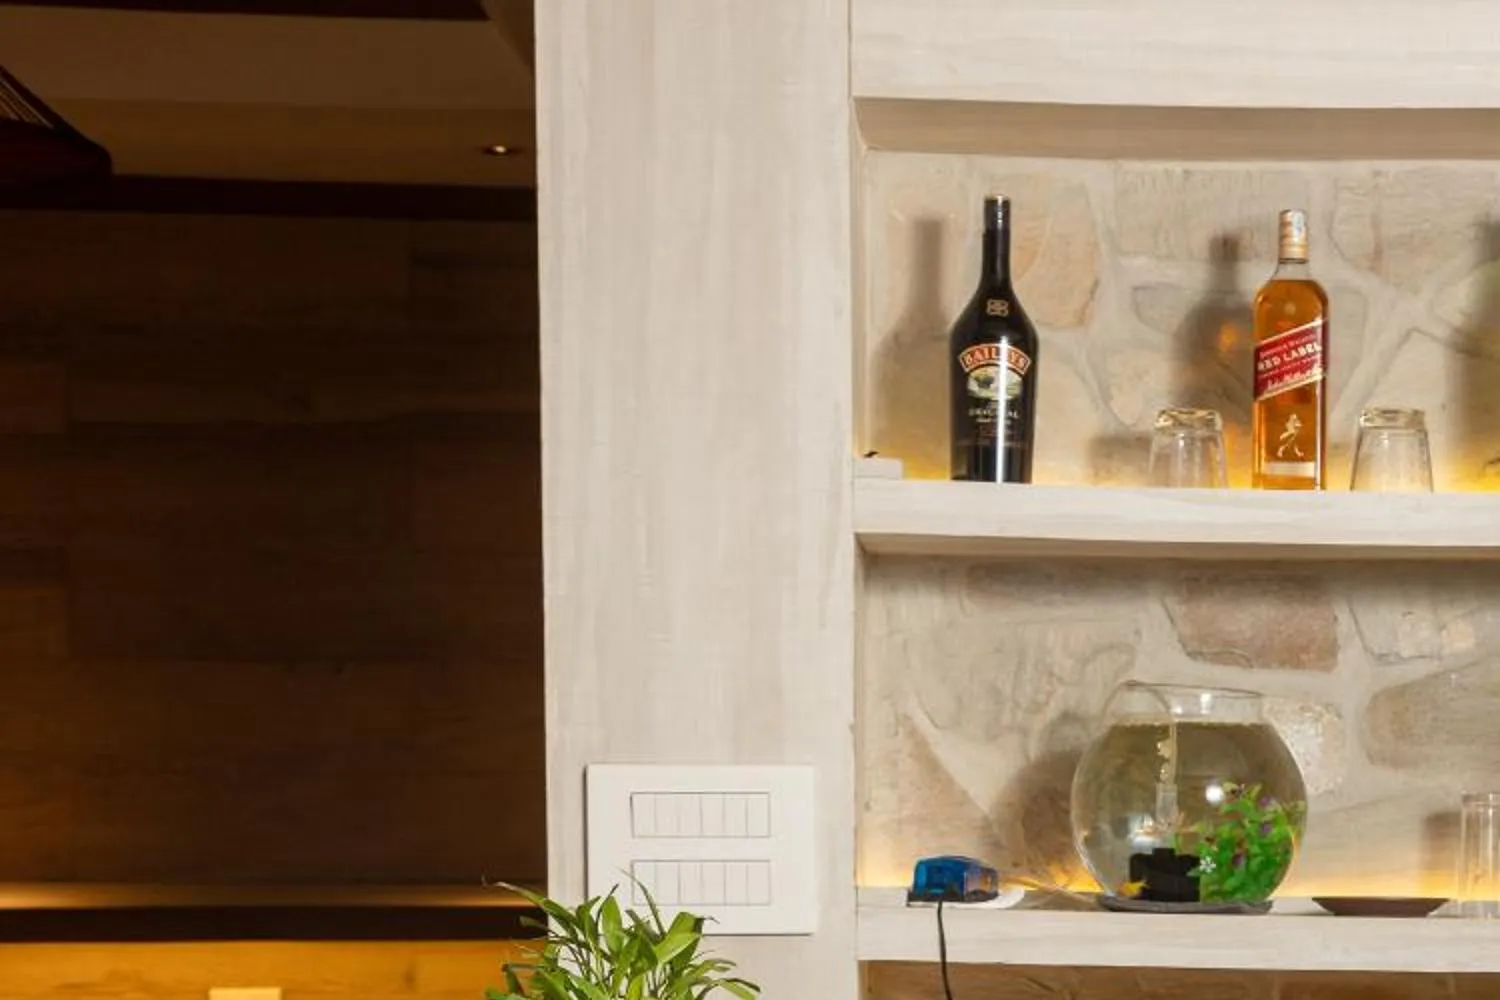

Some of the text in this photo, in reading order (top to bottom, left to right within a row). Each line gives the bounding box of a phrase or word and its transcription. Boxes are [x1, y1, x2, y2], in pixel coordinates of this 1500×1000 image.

[961, 346, 1028, 369] BAILYS
[1257, 356, 1282, 371] RED
[1283, 341, 1322, 361] LABEL
